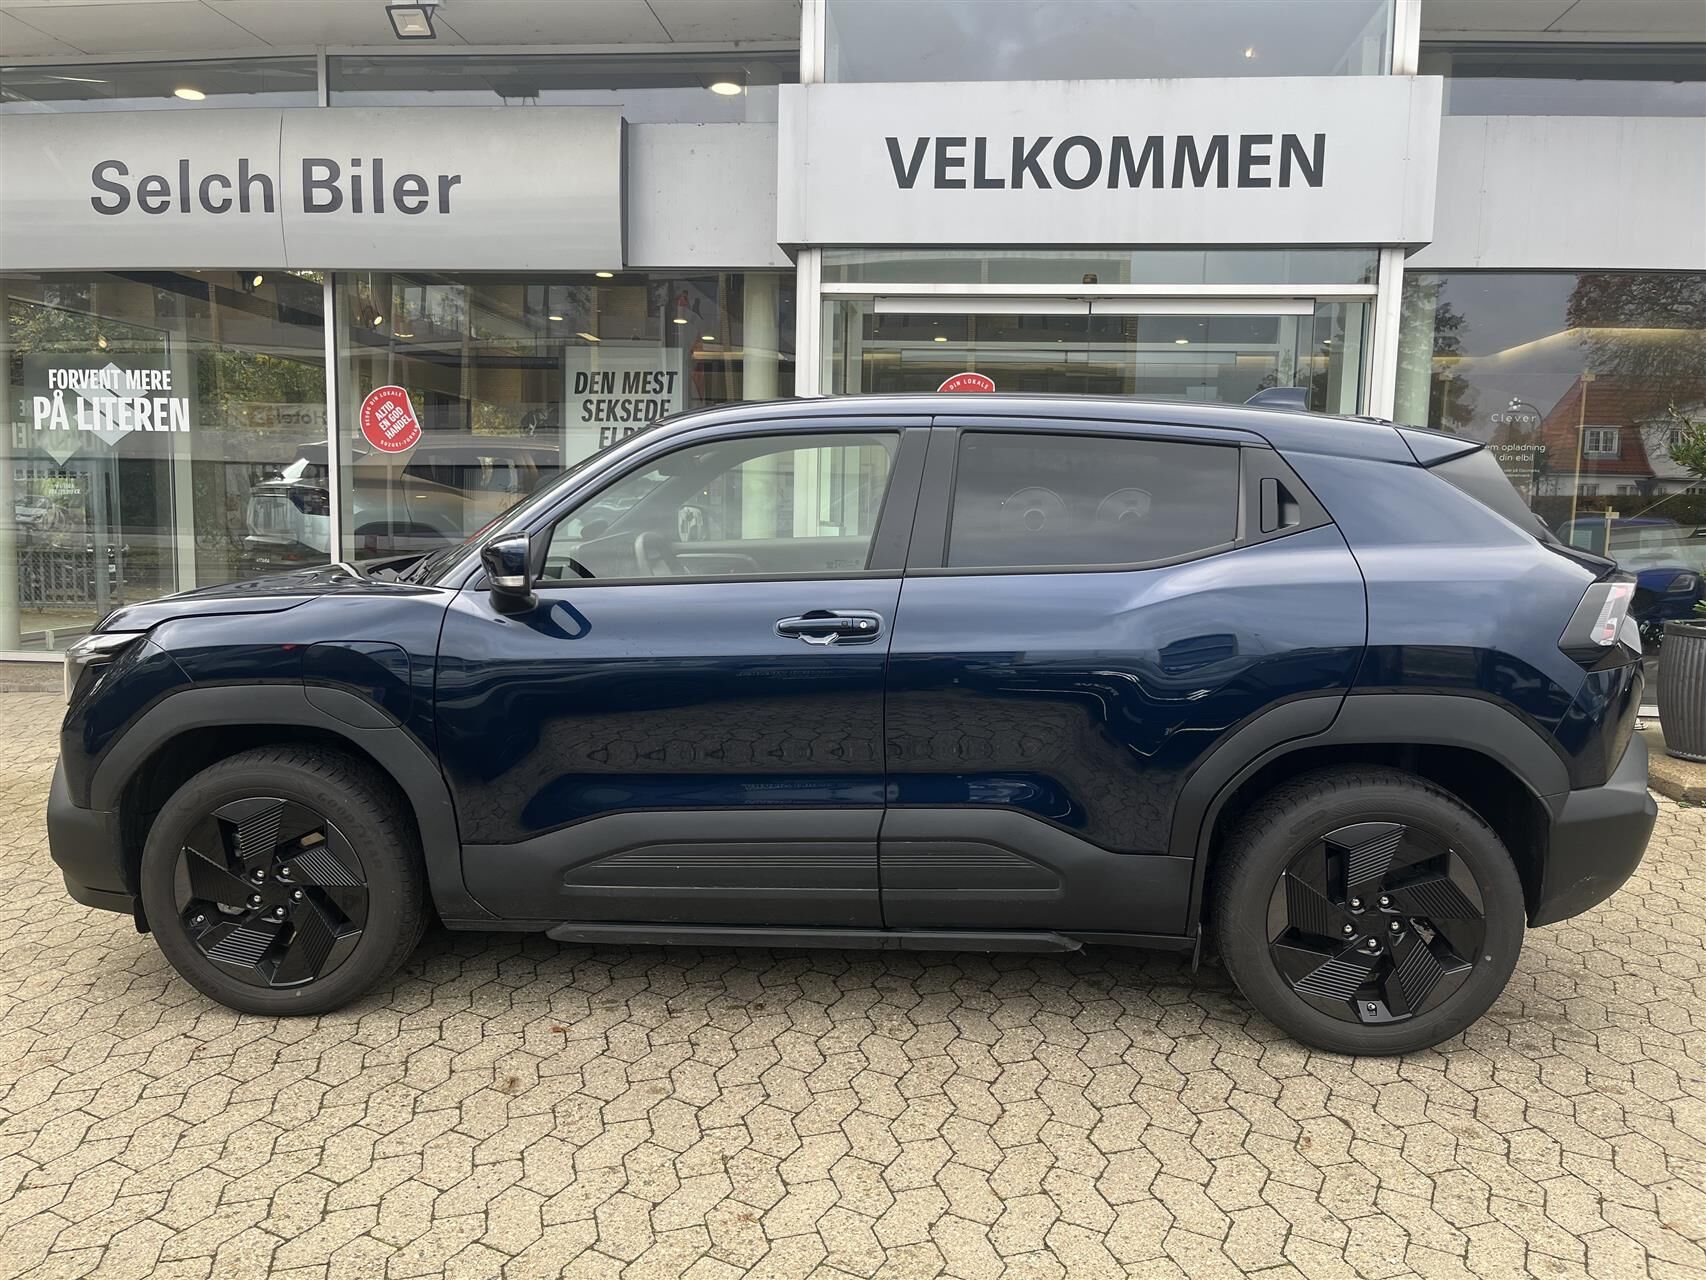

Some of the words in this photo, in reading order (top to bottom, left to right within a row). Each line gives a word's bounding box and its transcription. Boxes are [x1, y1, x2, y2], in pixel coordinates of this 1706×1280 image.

[885, 133, 1326, 190] VELKOMMEN
[90, 158, 275, 216] Selch
[302, 157, 461, 216] Biler
[48, 369, 120, 390] FORVENT
[125, 369, 172, 391] MERE
[574, 371, 616, 395] DEN
[621, 371, 678, 395] MEST
[963, 378, 989, 390] LOKALE
[33, 389, 70, 430] PÅ
[77, 396, 190, 433] LITEREN
[374, 400, 395, 422] ALTID
[378, 418, 392, 431] EN
[388, 406, 404, 422] GOD
[581, 399, 671, 422] SEKSEDE
[1491, 413, 1537, 423] Clever
[384, 414, 413, 440] HANDEL
[1499, 453, 1513, 462] din
[1516, 453, 1534, 462] elbil
[1501, 443, 1546, 453] opladning
